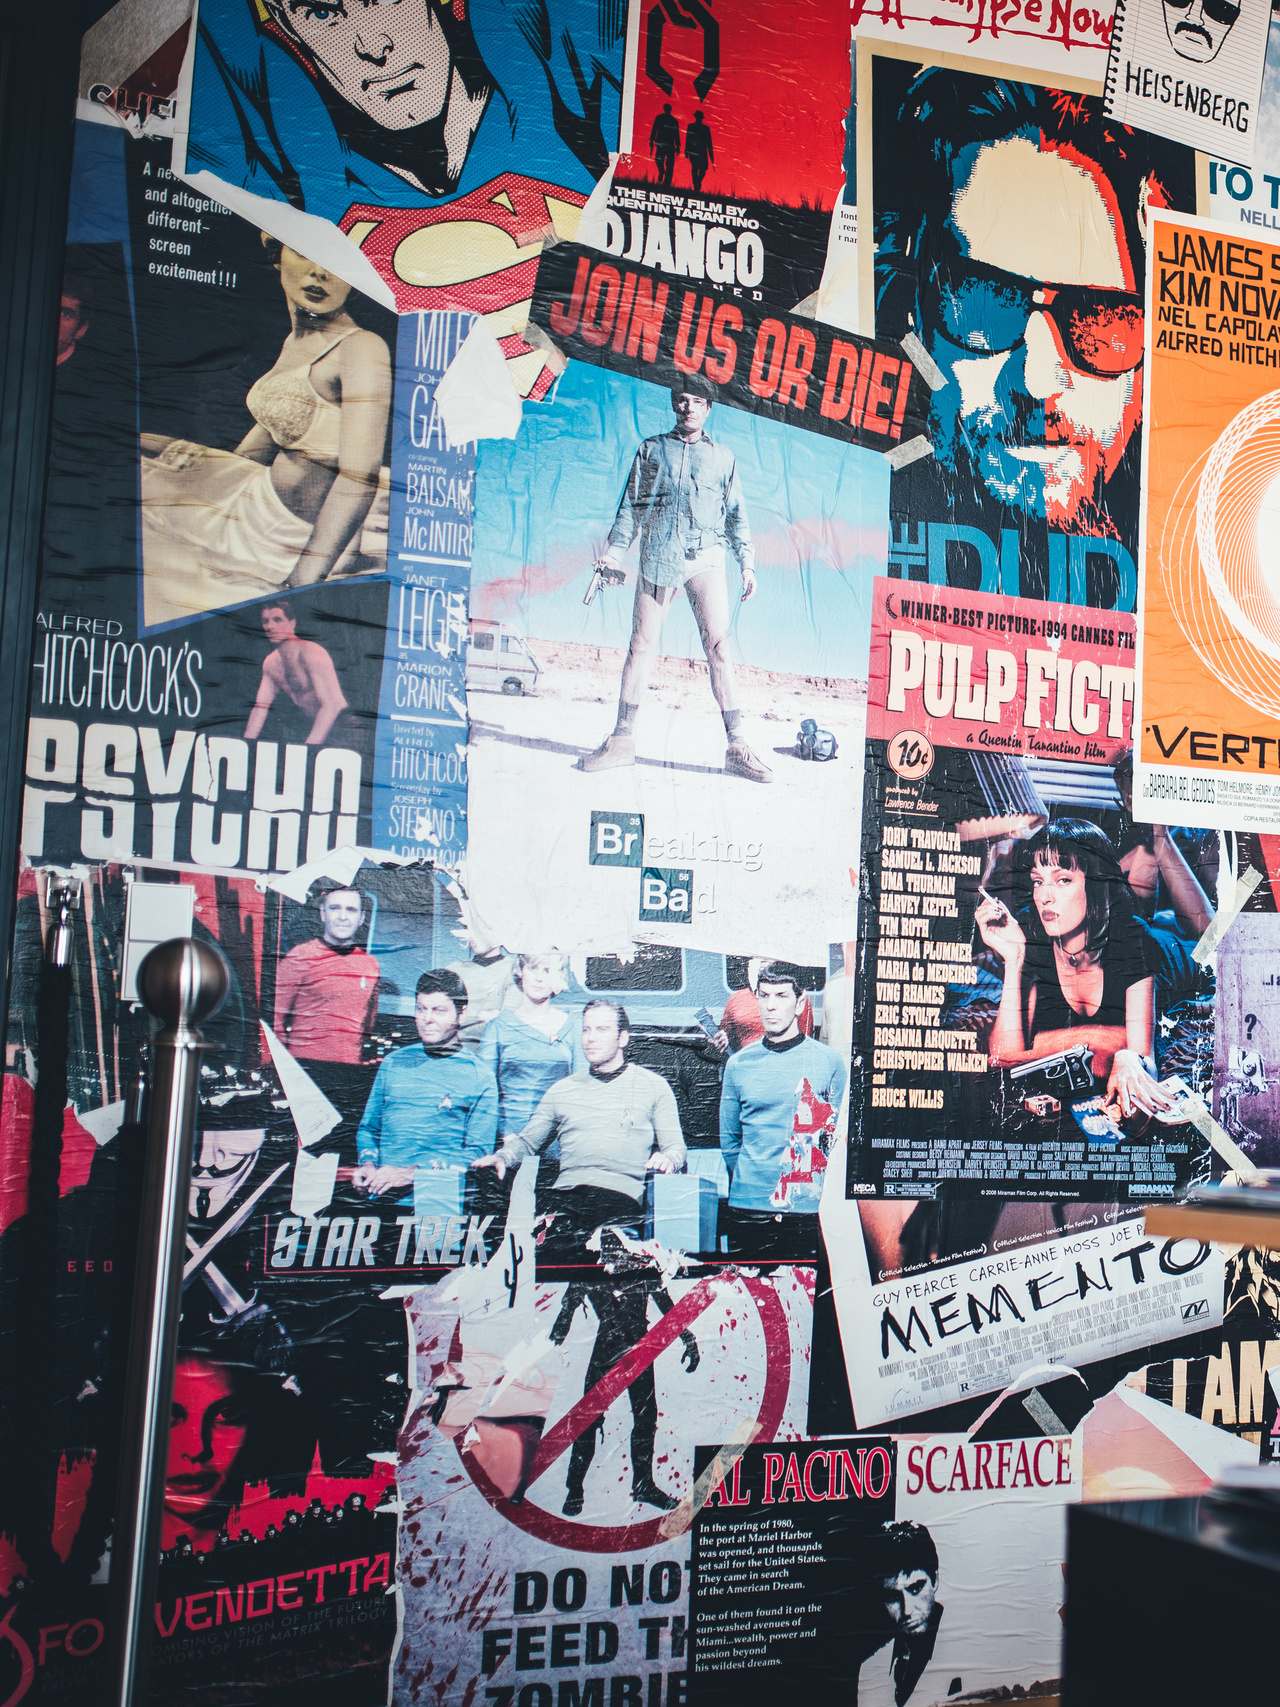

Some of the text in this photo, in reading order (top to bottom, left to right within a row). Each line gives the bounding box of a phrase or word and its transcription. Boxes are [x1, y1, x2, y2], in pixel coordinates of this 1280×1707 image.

[1126, 61, 1249, 133] HEISENBERG
[615, 186, 747, 218] THE NEW FILM BY
[675, 206, 759, 230] TARANTINO
[149, 238, 191, 256] screen
[601, 208, 764, 288] DJANGO
[1158, 232, 1263, 281] JAMES
[1160, 268, 1210, 306] KIM
[1158, 306, 1196, 329] NEL
[550, 256, 913, 439] JOIN US OR DIE!
[1156, 329, 1223, 357] ALFRED
[408, 463, 447, 475] MARTIN
[402, 574, 447, 588] JANET
[36, 612, 123, 636] ALFRED
[1071, 624, 1115, 647] CANNES
[33, 632, 203, 718] HITCHCOCK'S
[886, 629, 1018, 723] PULP
[395, 674, 450, 712] CRANE
[978, 729, 1106, 759] Quentin Tarantino film
[20, 716, 363, 872] PSYCHO
[1150, 773, 1178, 800] BARBARA
[1192, 777, 1215, 804] GEDDES
[885, 796, 939, 813] Lawrence Bender
[630, 818, 640, 826] 35
[882, 826, 961, 852] JOHN TRAVOLTA
[881, 849, 981, 876] SAMUEL JACKSON
[880, 871, 956, 895] UMA THURMAN
[879, 893, 958, 918] HARVEY KEITEL
[878, 915, 930, 938] TIM ROTH
[877, 938, 972, 963] AMANDA PLUMMER
[876, 959, 978, 985] MARIA de MEDEIROS
[875, 982, 945, 1005] VING RHAMES
[874, 1004, 941, 1027] ERIC STOLTZ
[874, 1027, 978, 1051] ROSANNA ARQUETTE
[873, 1049, 988, 1073] CHRISTOPHER WALKEN
[871, 1087, 944, 1109] BRUCE WILLIS
[853, 1183, 877, 1193] NECA
[1128, 1184, 1175, 1194] MIRAMAX
[270, 1215, 496, 1268] STAR TREK
[872, 1227, 1132, 1307] GUY PEARCE CARRIE-ANNE MOSS JOE
[880, 1237, 1212, 1360] MEMENTO
[704, 1438, 1073, 1508] AL PACINO SCARFACE
[716, 1530, 813, 1547] port Mariel Harbor
[729, 1519, 794, 1534] spring 1980,
[713, 1554, 827, 1570] sail United States.
[719, 1542, 823, 1559] opened, thousands
[513, 1560, 691, 1615] DO NO
[698, 1569, 789, 1585] They came search
[726, 1581, 805, 1594] American Dream.
[154, 1552, 390, 1638] VENDETTA
[730, 1606, 783, 1618] them found
[696, 1619, 790, 1634] sun-washed avenues
[480, 1621, 620, 1675] FEED
[695, 1632, 797, 1648] Miami...wealth, power
[695, 1645, 767, 1662] passion beyond
[711, 1657, 783, 1671] wildest dreams.
